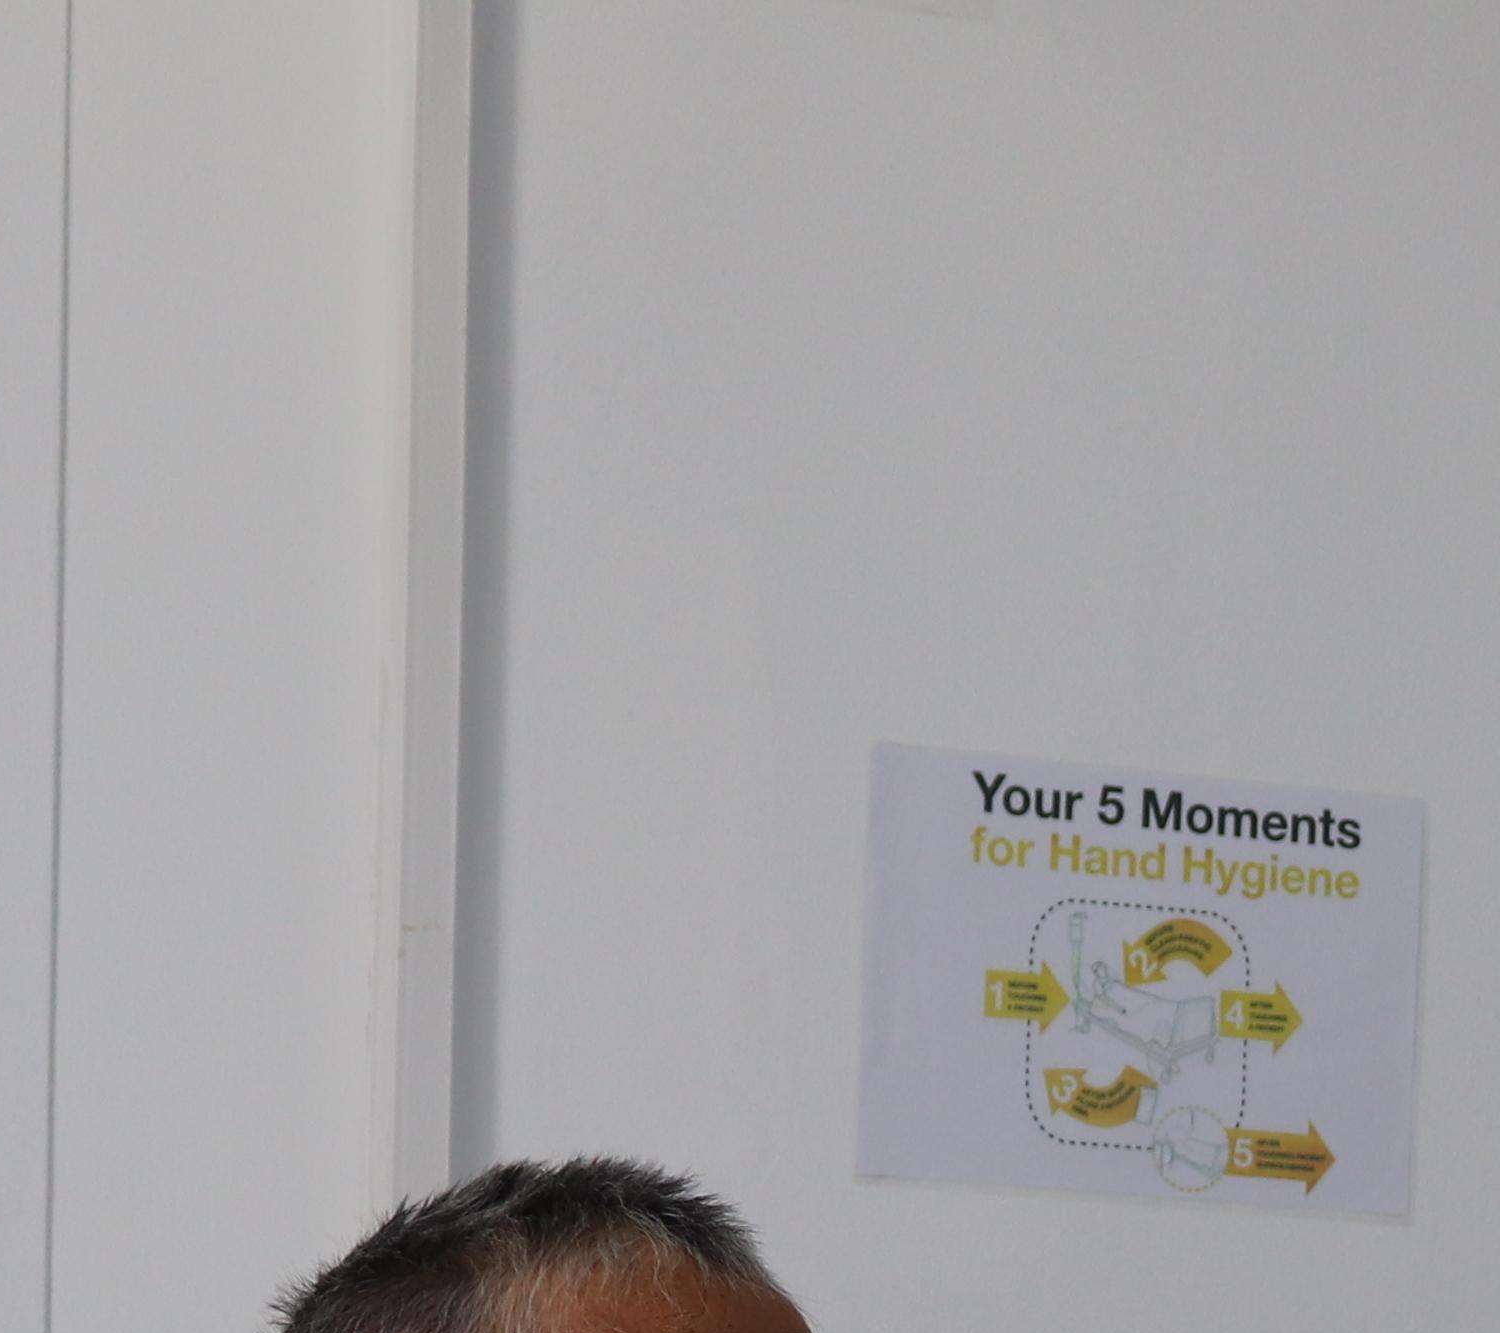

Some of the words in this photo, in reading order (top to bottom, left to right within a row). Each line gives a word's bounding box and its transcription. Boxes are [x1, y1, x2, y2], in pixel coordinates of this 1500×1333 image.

[972, 770, 1084, 821] Your
[1097, 784, 1126, 826] 5
[1141, 787, 1362, 850] Moments
[970, 825, 1036, 868] for
[1049, 832, 1167, 882] Hand
[1182, 844, 1362, 901] Hygiene
[1129, 948, 1160, 978] 2
[990, 979, 1005, 1011] 1
[1225, 1001, 1246, 1031] 4
[1232, 1137, 1256, 1169] 5
